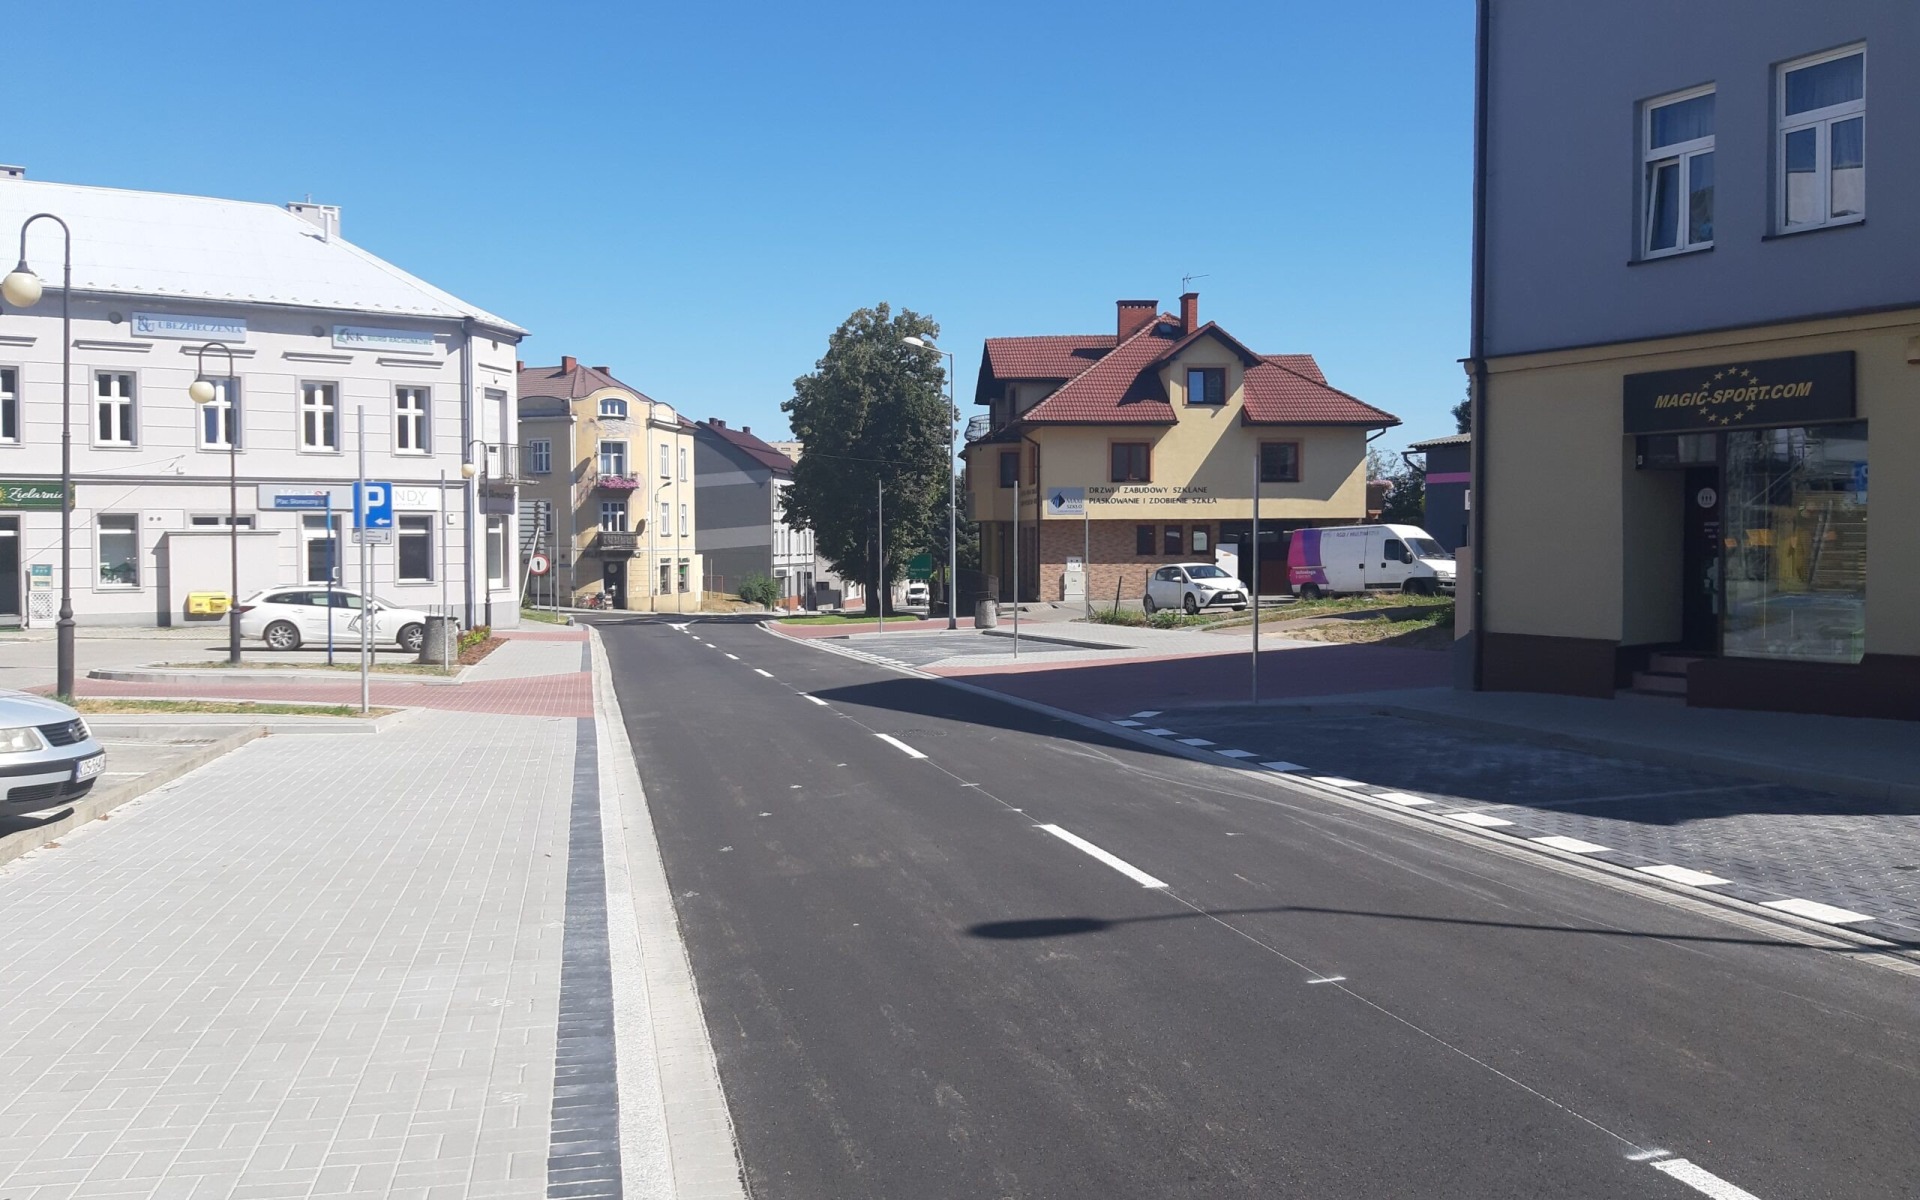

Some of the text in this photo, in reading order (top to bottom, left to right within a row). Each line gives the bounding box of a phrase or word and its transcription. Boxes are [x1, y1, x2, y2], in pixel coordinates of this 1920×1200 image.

[158, 321, 242, 334] UBEZPIECZENIA
[1654, 381, 1813, 409] MAGIC-SPORT.COM
[394, 490, 428, 502] NDY
[1089, 486, 1115, 494] DRZWI
[1123, 486, 1169, 494] ZABUDOWY
[1172, 486, 1208, 494] SZKLANE
[363, 486, 385, 515] P
[1089, 497, 1140, 505] PIASKOWANIE
[1149, 497, 1189, 505] ZDOBIENIE
[1191, 497, 1218, 505] SZKŁA
